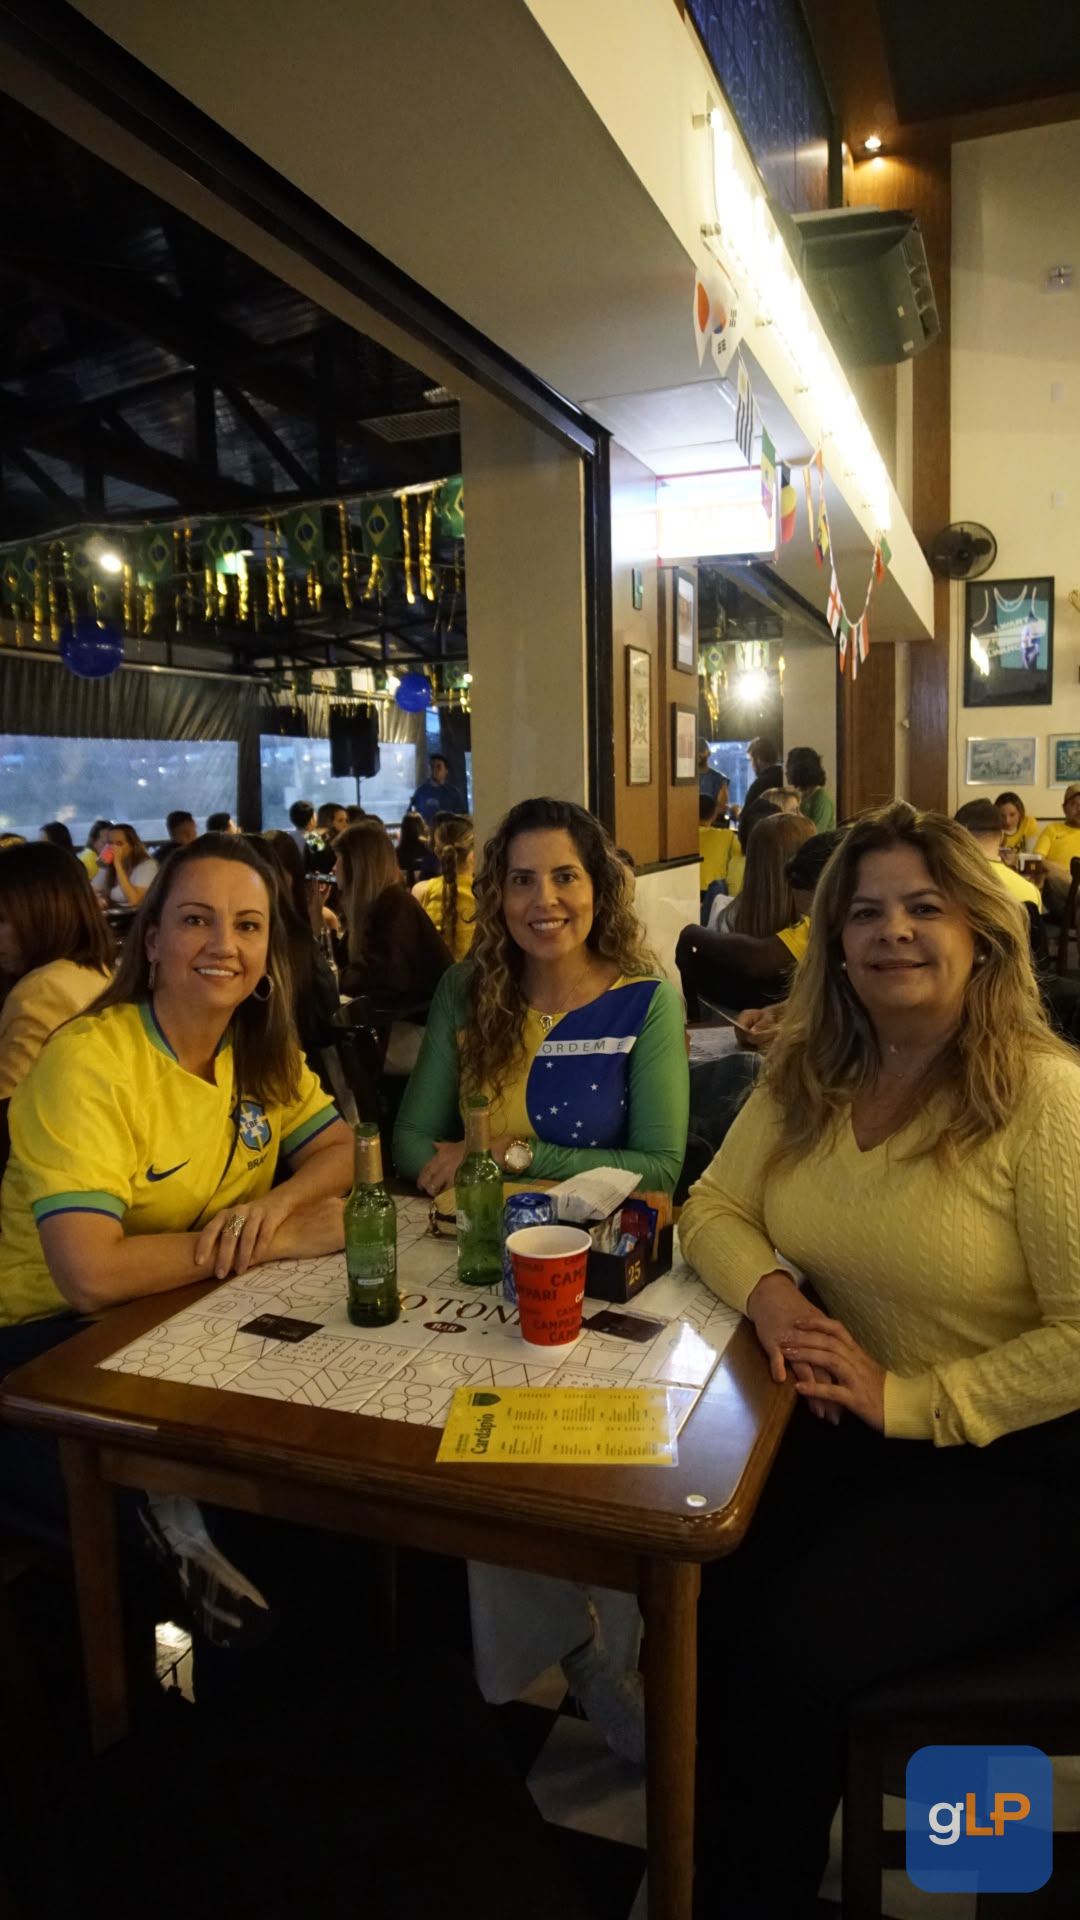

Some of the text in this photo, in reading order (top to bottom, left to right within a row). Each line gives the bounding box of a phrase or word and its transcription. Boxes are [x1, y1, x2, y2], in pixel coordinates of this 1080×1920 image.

[542, 1041, 606, 1054] ORDEM
[628, 1260, 641, 1286] 25
[400, 1294, 521, 1326] OTON
[431, 1322, 459, 1332] BAR
[470, 1413, 496, 1455] Cardápio
